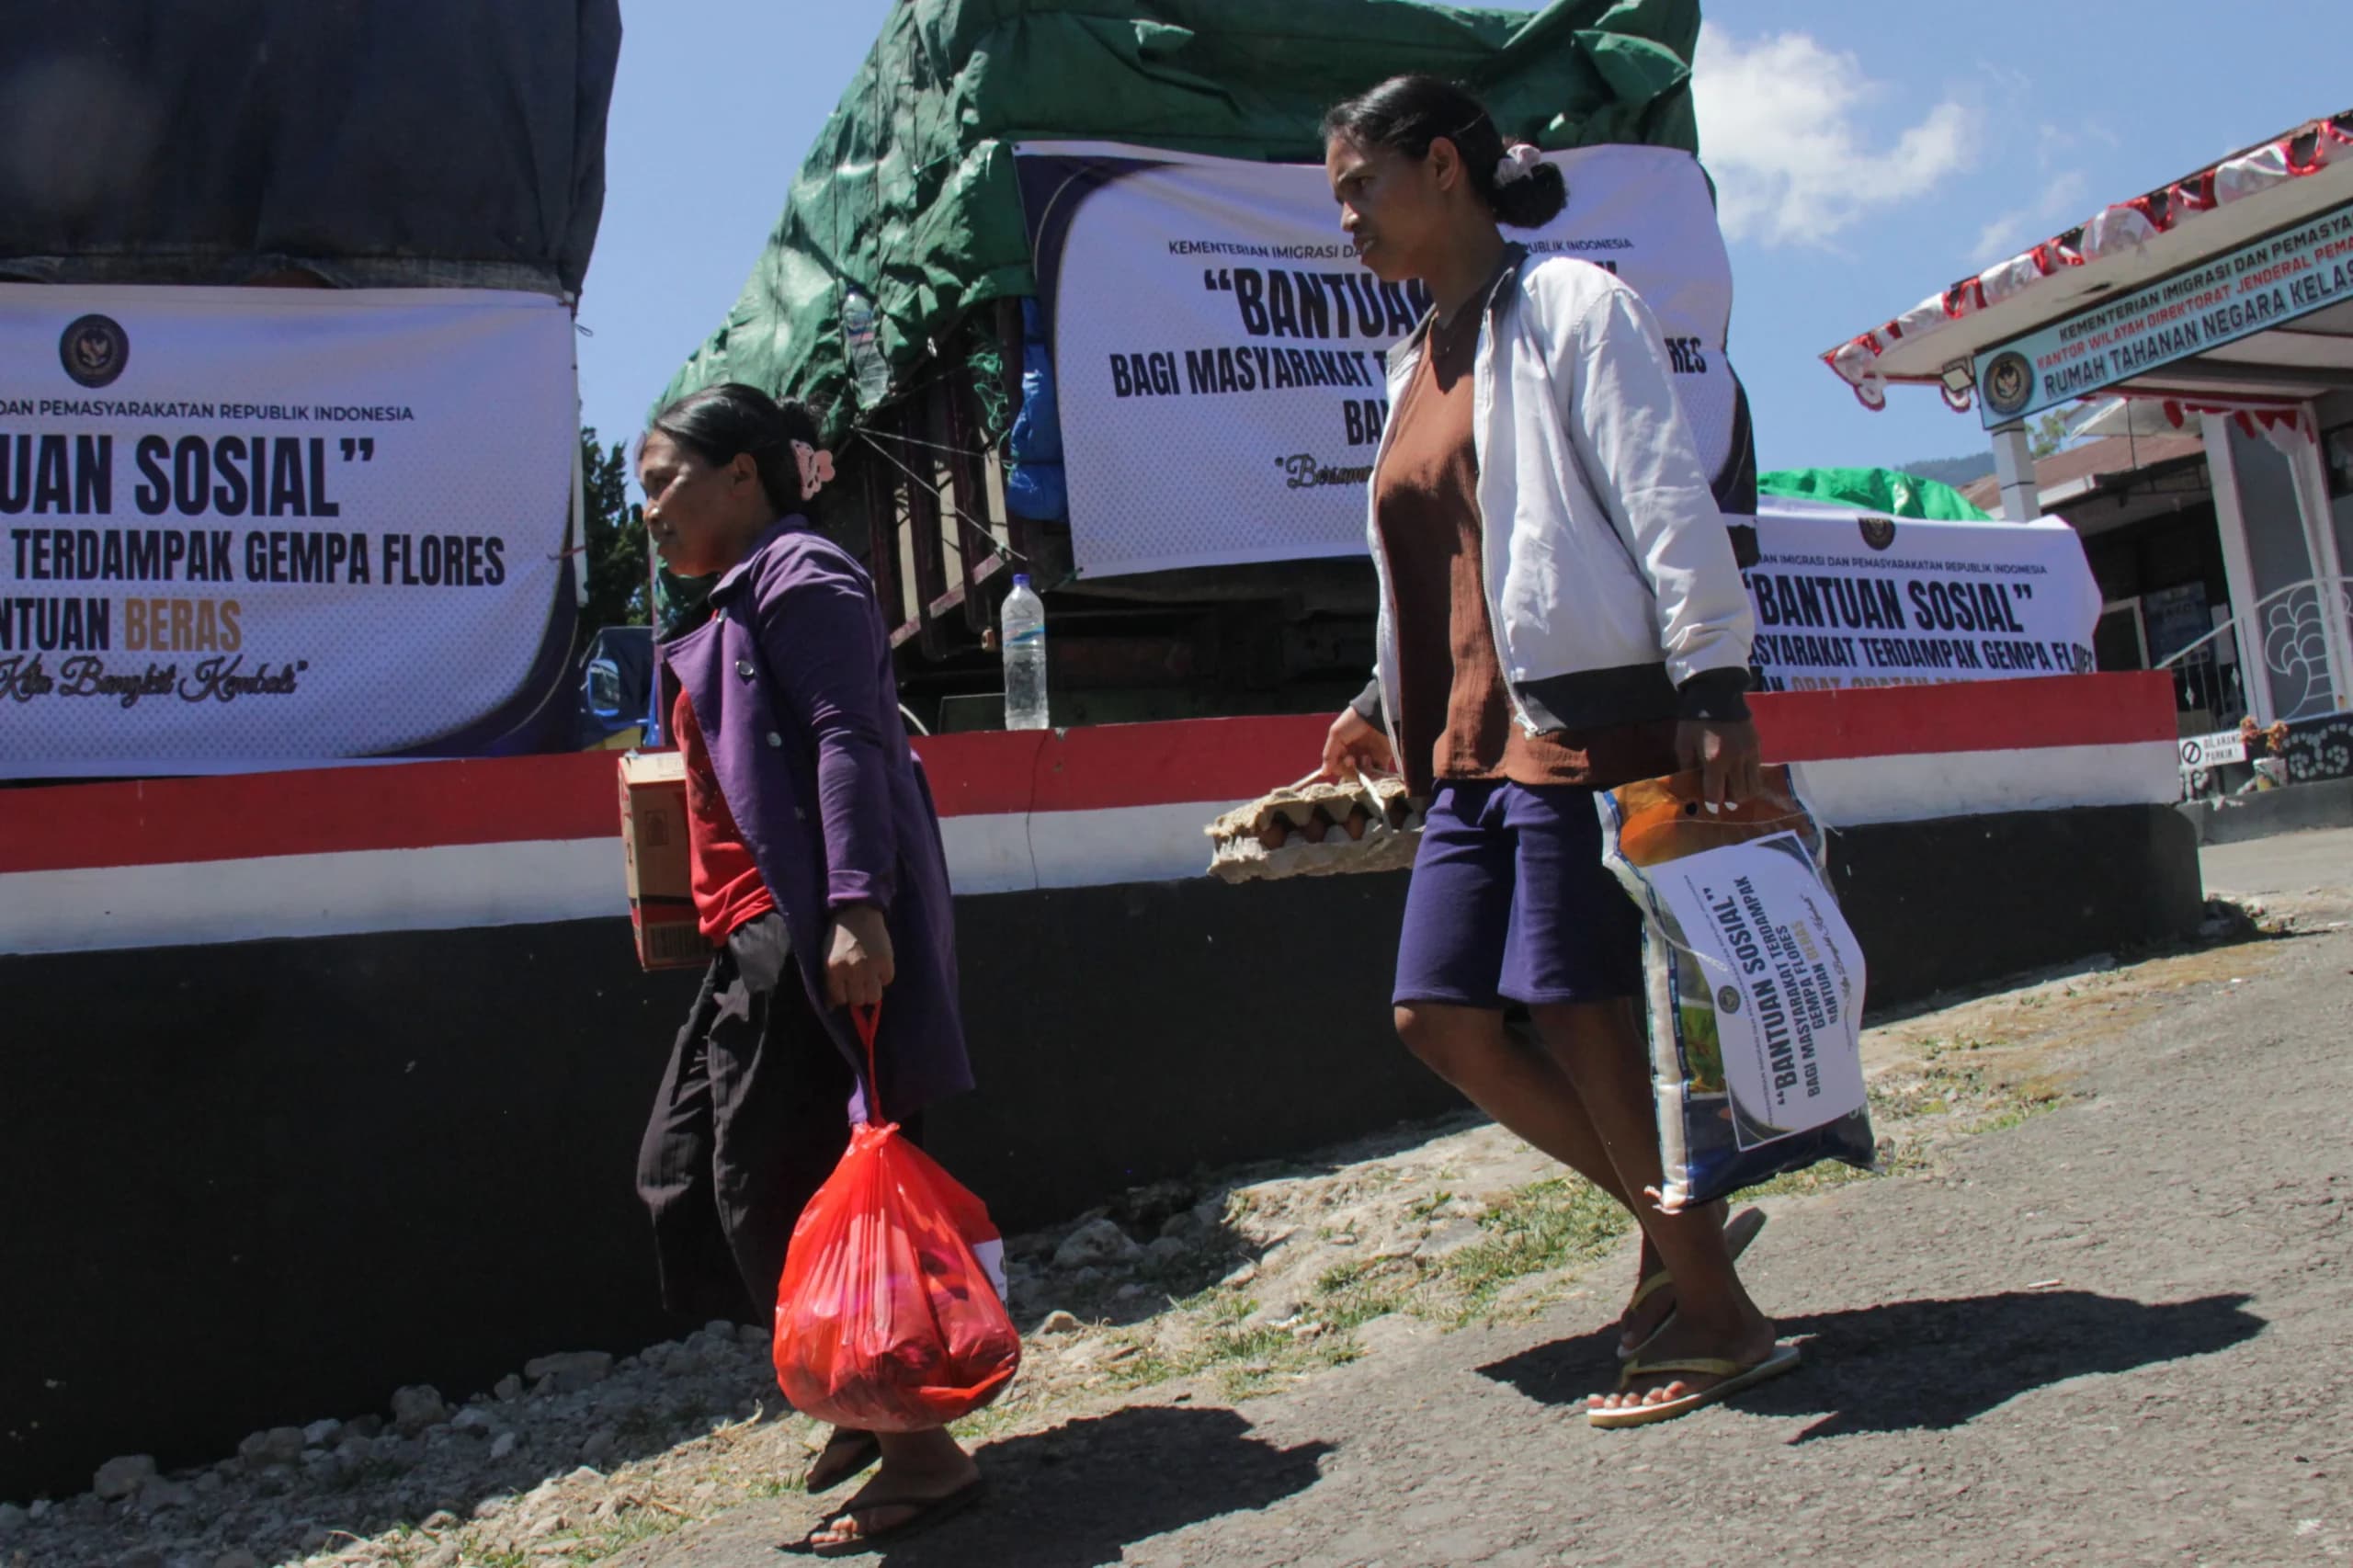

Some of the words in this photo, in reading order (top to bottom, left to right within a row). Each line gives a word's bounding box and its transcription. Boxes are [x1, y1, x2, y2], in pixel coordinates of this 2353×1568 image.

[1168, 240, 1270, 258] KEMENTERIAN
[1271, 244, 1339, 260] IMIGRASI
[1343, 244, 1366, 258] DA
[1525, 239, 1564, 254] UBLIK
[1566, 238, 1634, 252] INDONESIA
[2059, 291, 2159, 343] KEMENTERIAN
[2162, 263, 2232, 301] IMIGRASI
[2234, 248, 2268, 273] DAN
[2271, 211, 2353, 258] PEMASYA
[2036, 341, 2086, 369] KANTOR
[2087, 318, 2146, 350] WILAYAH
[2147, 284, 2231, 327] DIREKTORAT
[2236, 256, 2313, 294] JENDERAL
[1664, 336, 1708, 374] RES
[2043, 354, 2106, 399] RUMAH
[2109, 320, 2200, 372] TAHANAN
[2201, 288, 2287, 340] NEGARA
[1109, 351, 1181, 398] BAGI
[1185, 345, 1373, 395] MASYARAKAT
[39, 399, 215, 418] PEMASYARAKATAN
[220, 403, 310, 420] REPUBLIK
[313, 406, 415, 422] INDONESIA
[134, 434, 375, 517] SOSIAL”
[11, 528, 233, 583] TERDAMPAK
[244, 530, 371, 585] GEMPA
[382, 533, 506, 586] FLORES
[1779, 554, 1825, 567] IMIGRASI
[1827, 556, 1854, 568] DAN
[1852, 557, 1943, 572] PEMASYARAKATAN
[1944, 562, 1993, 574] REPUBLIK
[1993, 563, 2049, 575] INDONESIA
[124, 598, 243, 652] BERAS
[1906, 579, 2032, 633] SOSIAL”
[1747, 633, 1858, 667] ASYARAKAT
[1858, 637, 1984, 669] TERDAMPAK
[1981, 641, 2053, 671] GEMPA
[1733, 875, 1784, 960] TERDAMPAK
[1775, 924, 1809, 975] FLORES
[1774, 962, 1816, 1060] MASYARAKAT
[1799, 976, 1826, 1030] GEMPA
[1803, 1061, 1821, 1098] BAGI
